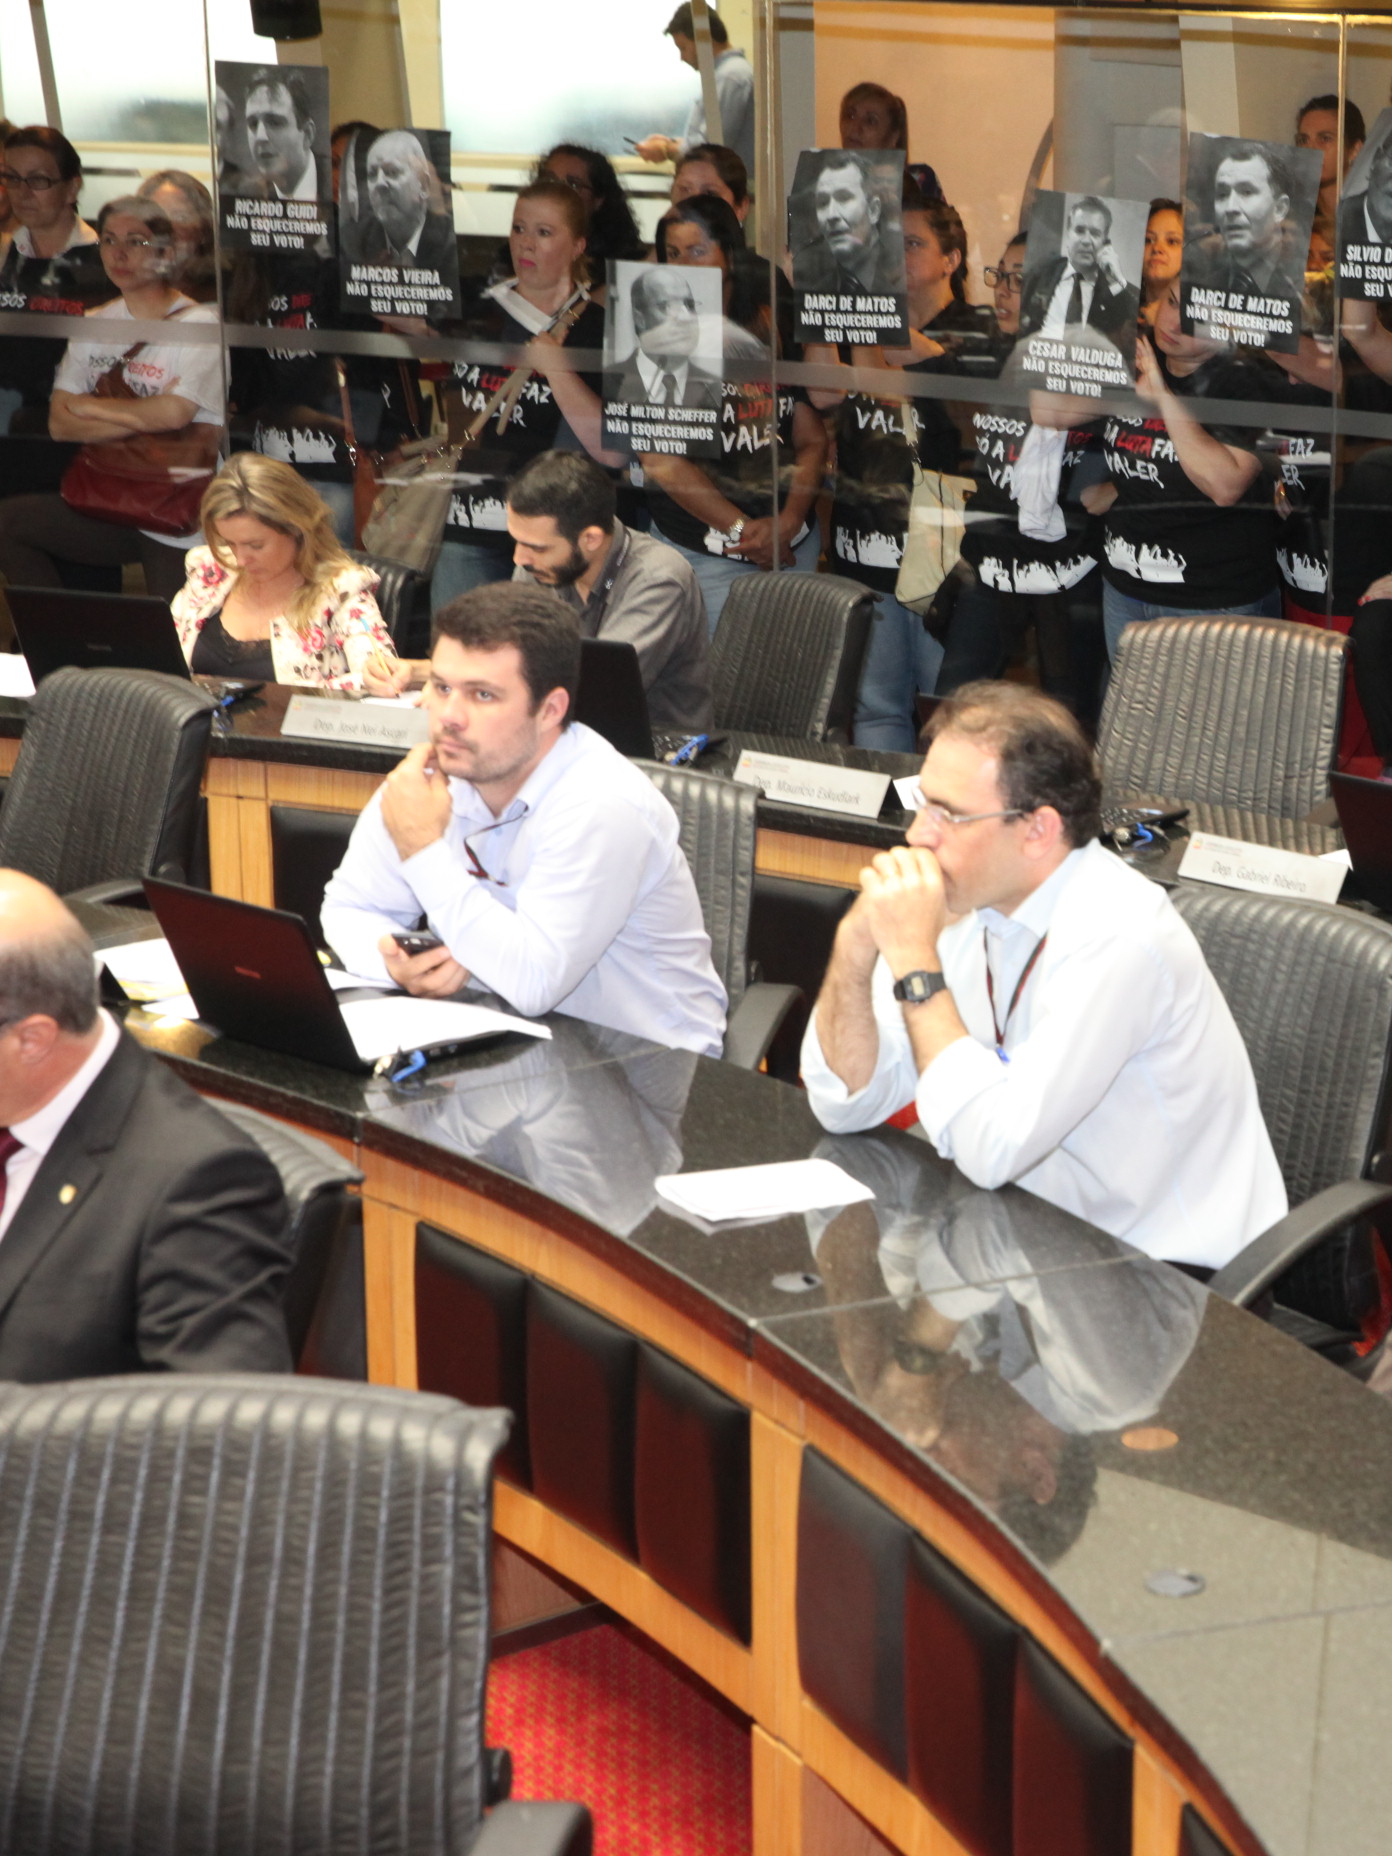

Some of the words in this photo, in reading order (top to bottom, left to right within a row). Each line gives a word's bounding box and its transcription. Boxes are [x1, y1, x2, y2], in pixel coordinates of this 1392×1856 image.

[235, 198, 283, 217] RICARDO
[287, 202, 318, 220] GUIDI
[226, 213, 248, 230] NÃO
[250, 217, 328, 235] ESQUECEREMOS
[250, 231, 270, 246] SEU
[274, 233, 304, 249] VOTO!
[1346, 245, 1382, 263] SILVIO
[351, 264, 399, 283] MARCOS
[402, 268, 440, 285] VIEIRA
[1340, 262, 1362, 279] NÃO
[346, 281, 368, 296] NÃO
[371, 283, 453, 301] ESQUECEREMOS
[1364, 282, 1384, 297] SEU
[370, 299, 391, 313] SEU
[394, 300, 428, 315] VOTO!
[804, 294, 836, 310] DARCI
[839, 295, 853, 311] DE
[856, 296, 896, 313] MATOS
[1191, 287, 1226, 307] DARCI
[1228, 292, 1244, 310] DE
[1246, 295, 1290, 317] MATOS
[800, 310, 822, 325] NÃO
[825, 313, 902, 328] ESQUECEREMOS
[1186, 303, 1208, 320] NÃO
[1211, 308, 1293, 334] ESQUECEREMOS
[825, 328, 843, 342] SEU
[846, 329, 877, 344] VOTO!
[1210, 326, 1229, 341] SEU
[1233, 329, 1265, 347] VOTO!
[1028, 340, 1066, 360] CESAR
[1071, 346, 1123, 368] VALDUGA
[1023, 356, 1045, 373] NÃO
[1048, 361, 1127, 385] ESQUECEREMOS
[1046, 376, 1066, 392] SEU
[1070, 380, 1102, 397] VOTO!
[605, 403, 628, 417] JOSÉ
[630, 405, 665, 420] MILTON
[668, 408, 717, 423] SCHEFFER
[607, 418, 629, 434] NÃO
[632, 421, 714, 441] ESQUECEREMOS
[972, 411, 1027, 438] NOSSOS
[631, 437, 650, 452] SEU
[654, 439, 687, 454] VOTO!
[1103, 447, 1165, 490] VALER
